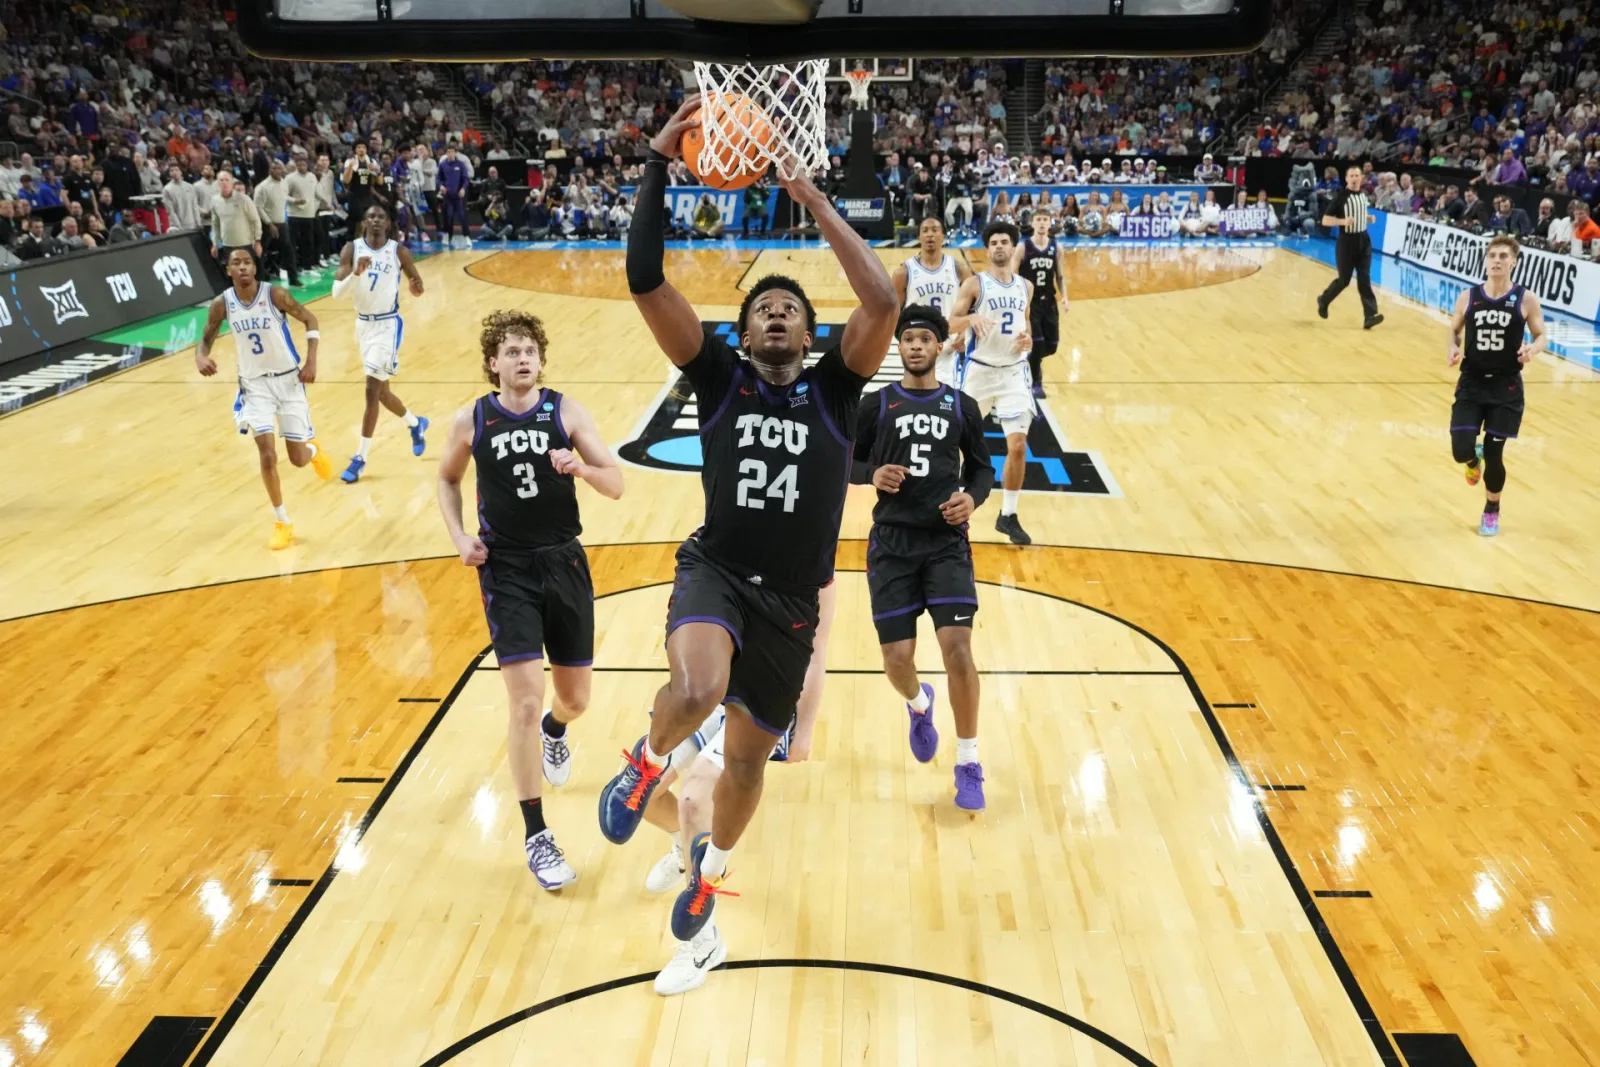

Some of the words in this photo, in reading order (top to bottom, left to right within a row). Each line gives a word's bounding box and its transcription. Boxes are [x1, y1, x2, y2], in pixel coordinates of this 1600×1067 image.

[1151, 216, 1170, 238] GO
[1029, 257, 1054, 269] TCU
[1401, 221, 1436, 261] FIRST
[1511, 251, 1578, 306] OUNDS
[152, 255, 194, 296] TCU
[368, 272, 379, 291] 7
[1036, 272, 1046, 286] 2
[105, 272, 138, 304] TCU
[916, 282, 954, 298] DUKE
[988, 296, 1026, 312] DUKE
[232, 317, 271, 334] DUKE
[1001, 312, 1014, 334] 2
[1473, 309, 1512, 328] TCU
[248, 332, 265, 355] 3
[1476, 328, 1505, 351] 55
[735, 413, 809, 456] TCU
[895, 413, 950, 441] TCU
[490, 429, 550, 461] TCU
[909, 443, 932, 477] 5
[512, 462, 540, 499] 3
[736, 457, 800, 513] 24
